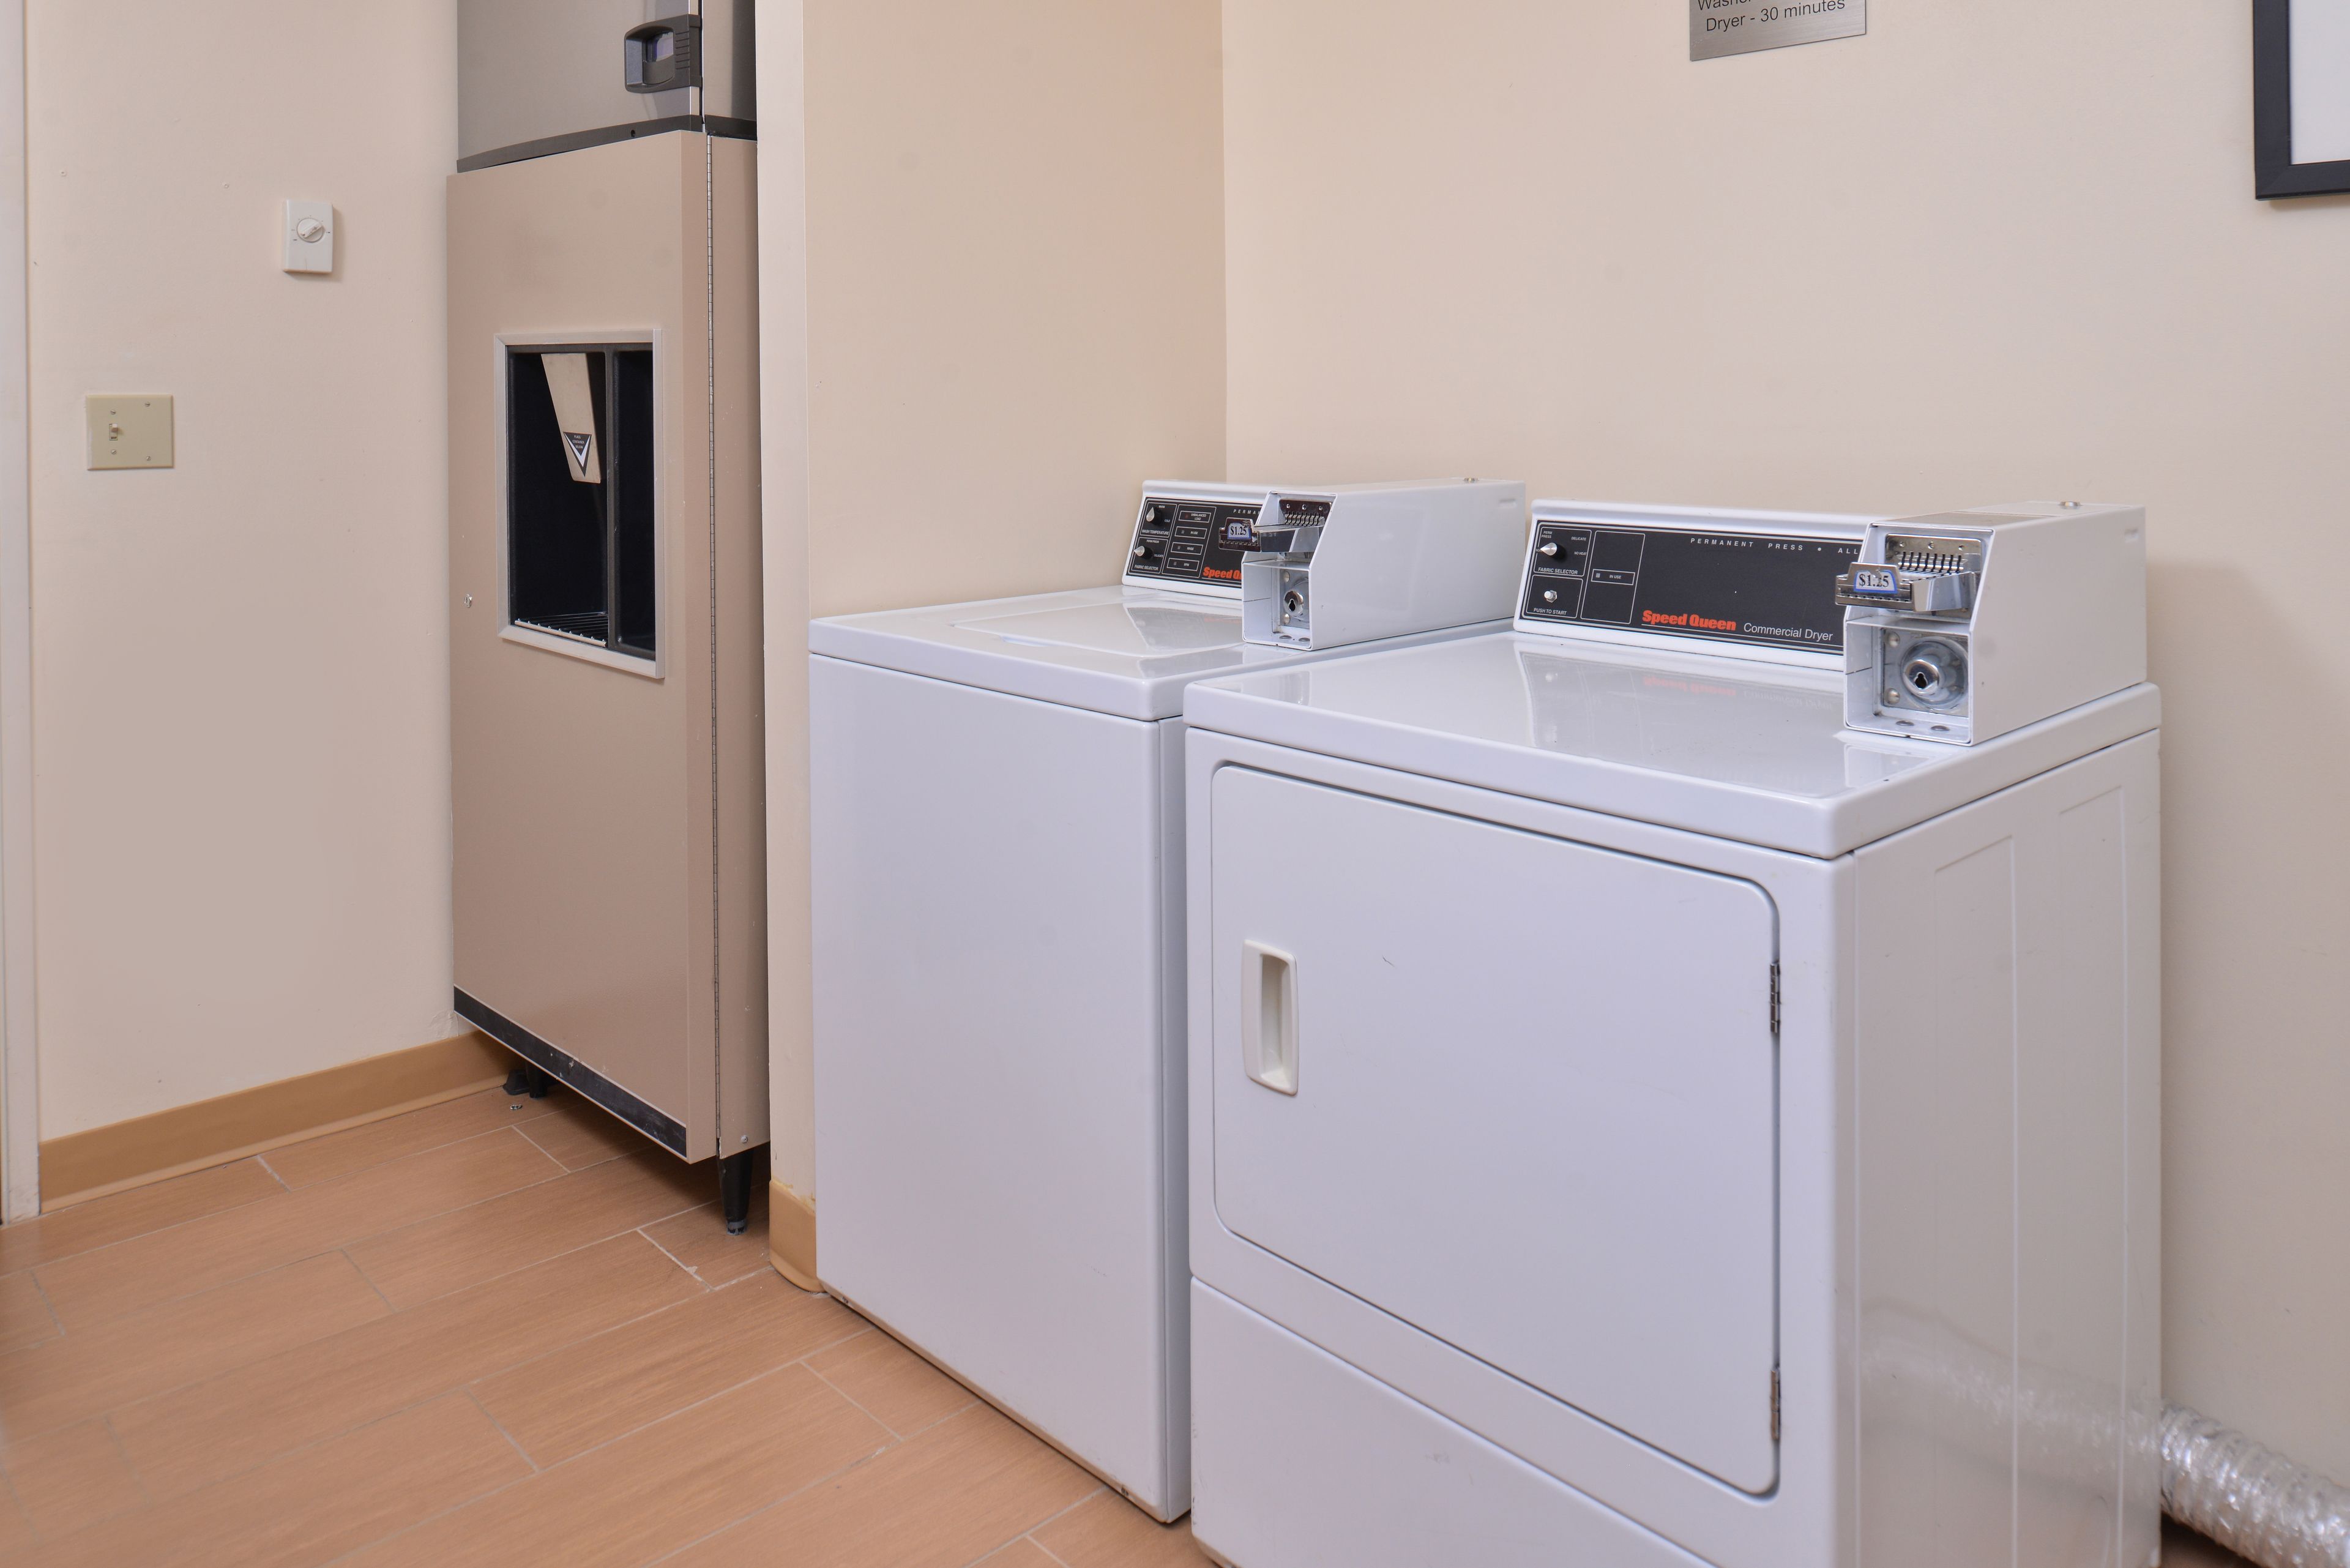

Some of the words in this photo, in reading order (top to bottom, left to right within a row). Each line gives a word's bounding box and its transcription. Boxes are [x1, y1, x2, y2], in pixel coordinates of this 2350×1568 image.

[1698, 0, 1751, 10] Was
[1706, 15, 1746, 32] Dryer
[1761, 7, 1778, 22] 30
[1784, 0, 1845, 18] minutes
[1230, 525, 1247, 536] $1.25
[1690, 538, 1754, 548] PERMANENT
[1203, 567, 1233, 579] Speed
[1642, 610, 1688, 625] Speed
[1689, 614, 1737, 632] Queen
[1744, 622, 1802, 638] Commercial
[1804, 629, 1833, 642] Dryer
